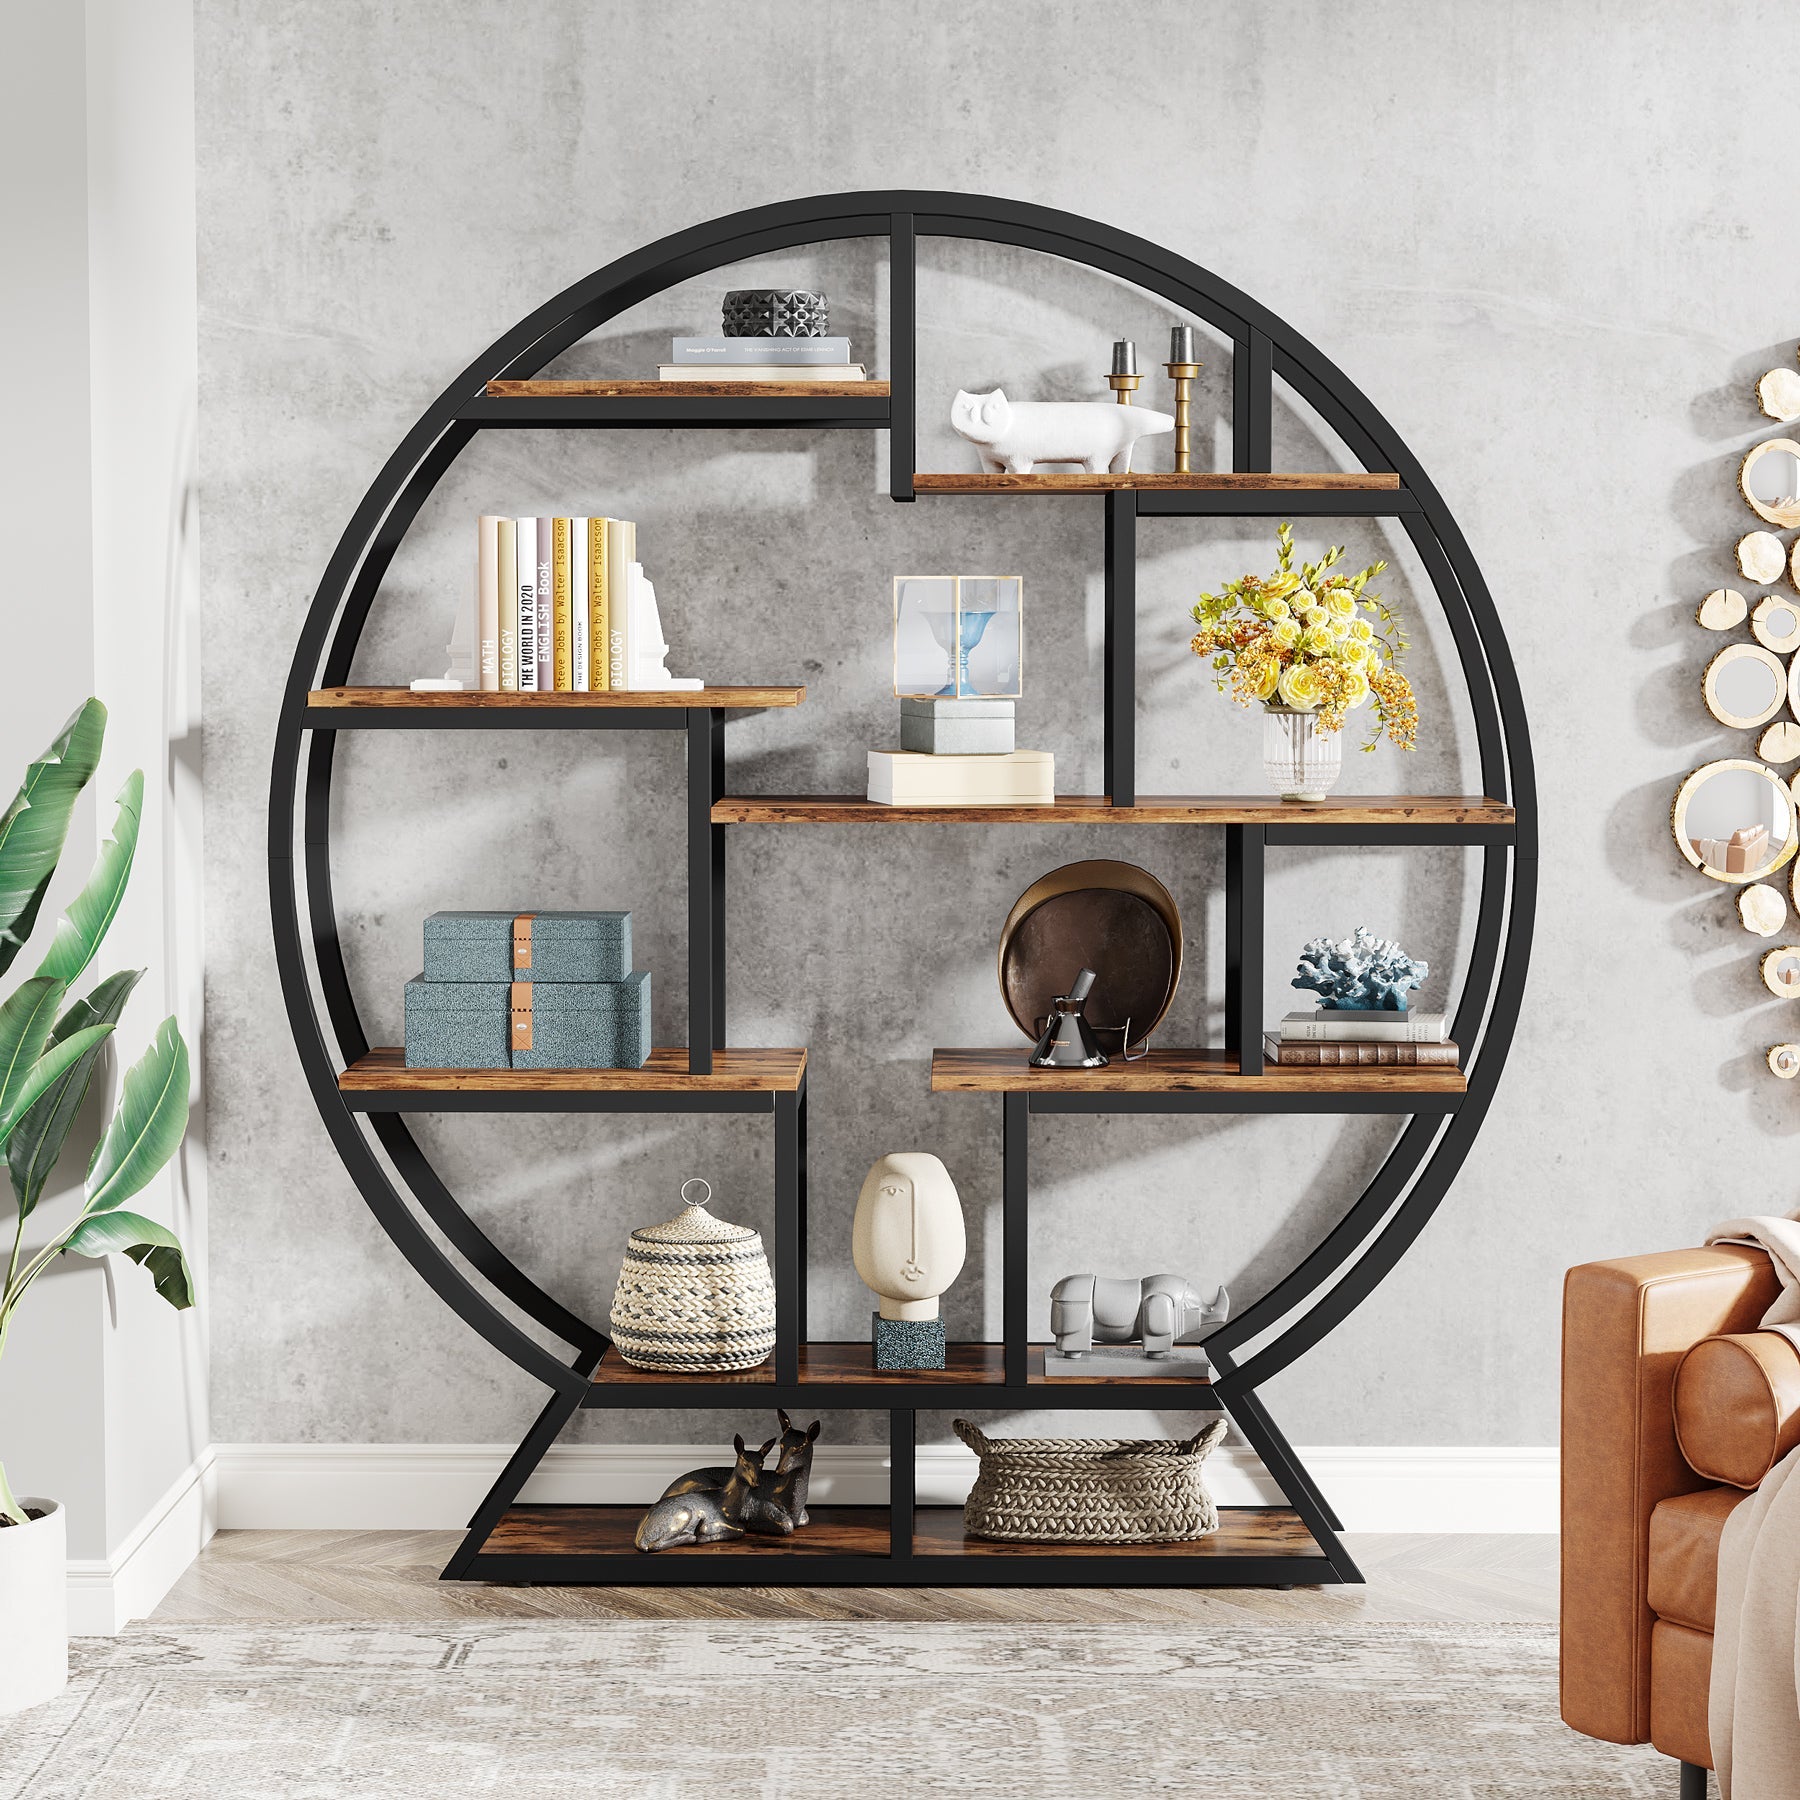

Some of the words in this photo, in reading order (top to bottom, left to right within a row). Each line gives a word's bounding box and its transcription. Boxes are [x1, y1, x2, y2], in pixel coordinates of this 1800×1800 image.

[556, 519, 566, 566] Isaacson
[593, 519, 603, 566] Isaacson
[537, 561, 550, 595] Book
[556, 571, 566, 607] Walter
[593, 571, 603, 607] Walter
[521, 585, 534, 612] 2020
[521, 615, 534, 626] IN
[538, 604, 550, 663] ENGLISH
[556, 612, 567, 624] by
[593, 612, 604, 624] by
[482, 639, 495, 674] MATH
[501, 628, 514, 687] BIOLOGY
[521, 628, 534, 666] WORLD
[556, 630, 566, 653] Jobs
[593, 630, 603, 653] Jobs
[610, 628, 623, 687] BIOLOGY
[521, 668, 534, 687] THE
[556, 658, 566, 689] Steve
[593, 658, 603, 689] Steve
